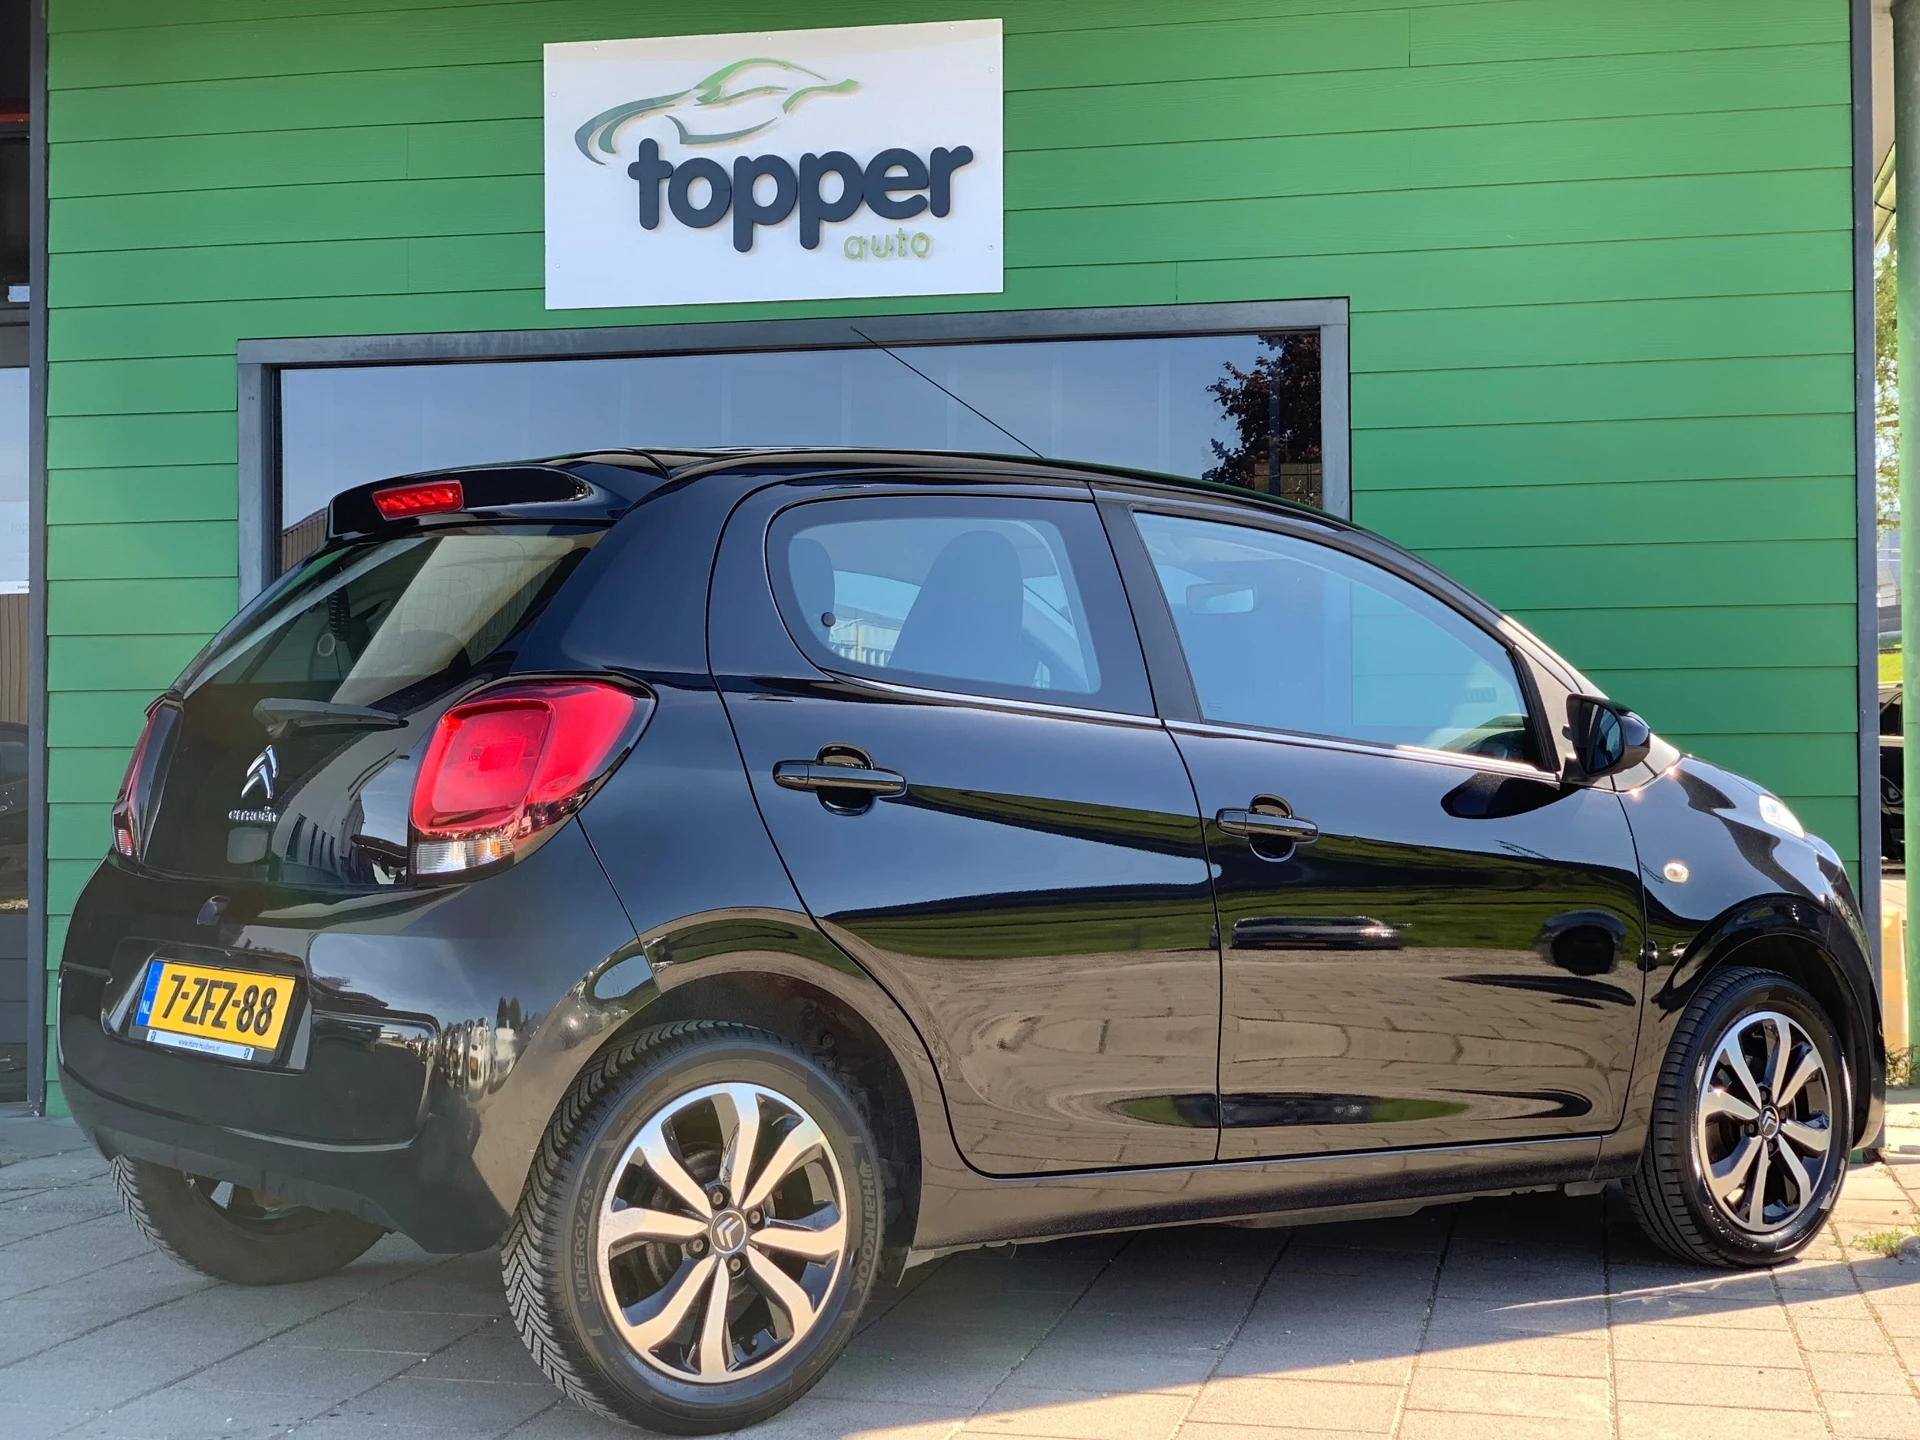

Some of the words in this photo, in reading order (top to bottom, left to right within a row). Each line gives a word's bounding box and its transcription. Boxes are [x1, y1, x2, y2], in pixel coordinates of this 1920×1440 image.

[627, 138, 974, 253] topper
[843, 227, 933, 259] auto
[141, 1000, 152, 1015] NL
[162, 974, 278, 1037] 7-ZFZ-88
